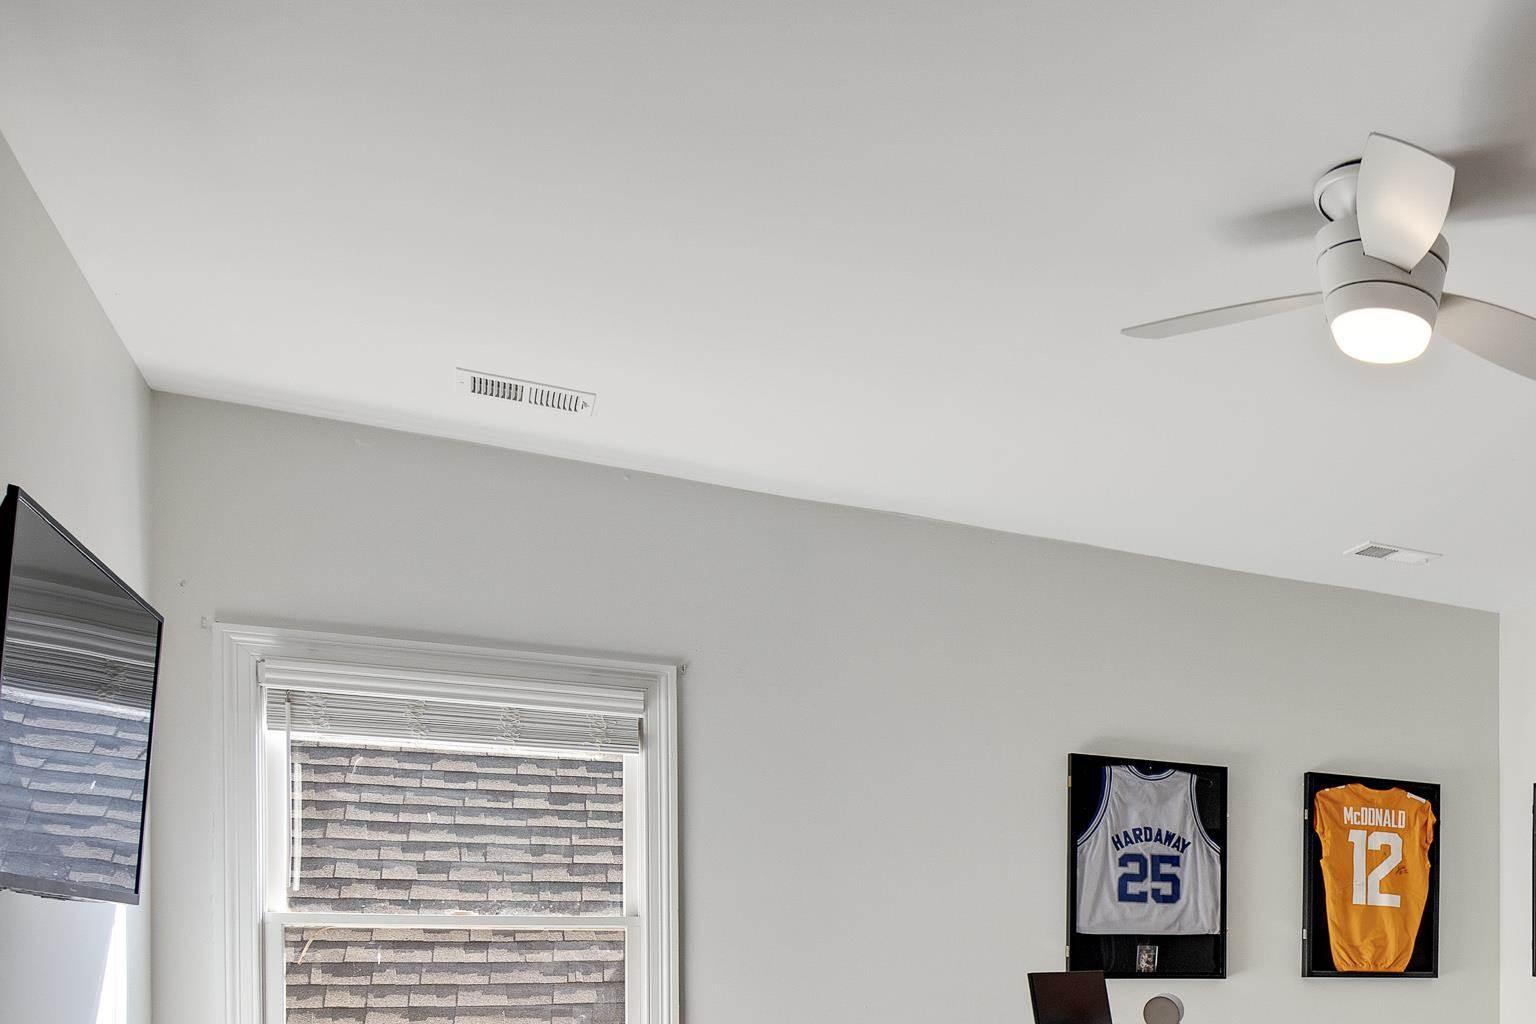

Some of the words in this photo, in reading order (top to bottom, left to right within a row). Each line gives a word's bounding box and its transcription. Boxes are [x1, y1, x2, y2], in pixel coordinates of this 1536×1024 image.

[1343, 806, 1406, 828] McDONALD
[1111, 826, 1191, 854] HARDAWAY
[1118, 853, 1180, 904] 25
[1348, 829, 1403, 908] 12
